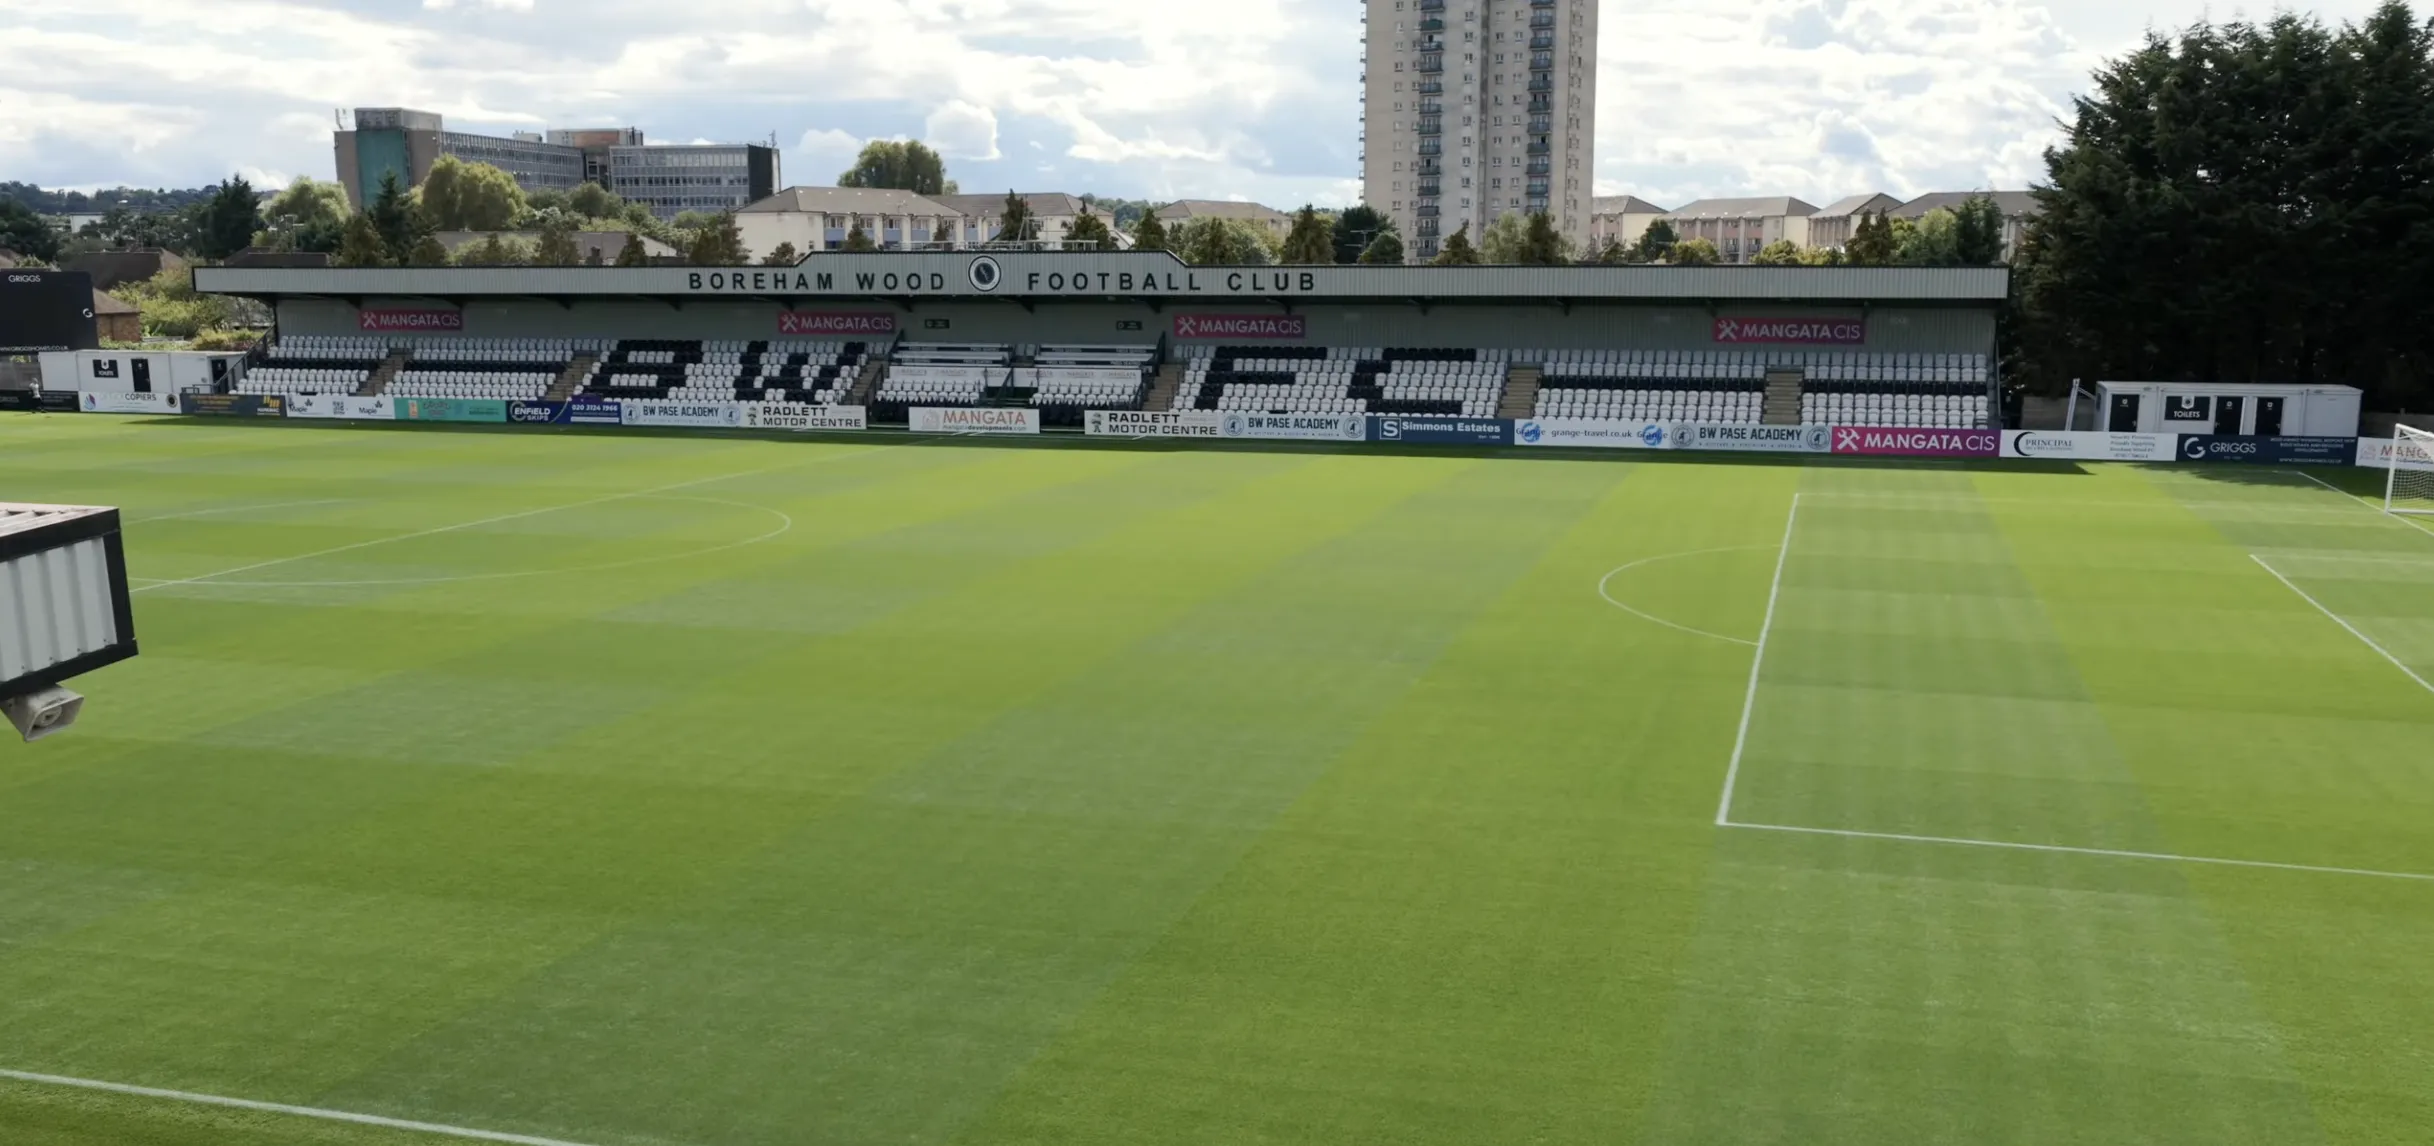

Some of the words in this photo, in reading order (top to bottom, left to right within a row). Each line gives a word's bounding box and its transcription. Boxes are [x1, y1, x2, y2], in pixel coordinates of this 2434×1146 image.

[8, 275, 41, 283] GRIGGS
[689, 272, 833, 290] BOREHAM
[856, 272, 944, 290] WOOD
[1028, 272, 1201, 291] FOOTBALL
[1227, 272, 1315, 291] CLUB
[379, 314, 440, 327] MANGATA
[440, 314, 461, 327] CIS
[801, 316, 869, 330] MANGATA
[871, 317, 893, 331] CIS
[1200, 319, 1277, 333] MANGATA
[1278, 320, 1302, 334] CIS
[1742, 323, 1832, 338] MANGATA
[1833, 325, 1861, 339] CIS
[125, 393, 156, 401] COPIERS
[290, 406, 308, 414] Maple
[359, 407, 378, 415] Maple
[514, 407, 551, 415] ENFIELD
[643, 405, 656, 416] BW
[658, 406, 679, 417] PASE
[681, 406, 719, 417] ACADEMY
[763, 406, 828, 417] RADLETT
[2173, 410, 2201, 418] TOILETS
[763, 417, 807, 426] MOTOR
[811, 418, 862, 428] CENTRE
[943, 410, 1026, 425] MANGATA
[1108, 412, 1181, 424] RADLETT
[1248, 417, 1263, 428] BW
[1266, 417, 1290, 429] PASE
[1293, 418, 1340, 430] ACADEMY
[1108, 424, 1158, 434] MOTOR
[1162, 425, 1218, 436] CENTRE
[1402, 421, 1454, 432] Simmons
[1457, 422, 1501, 433] Estates
[1551, 429, 1632, 438] grange-travel.co.uk
[1699, 427, 1717, 439] BW
[1720, 428, 1747, 440] PASE
[1750, 428, 1802, 441] ACADEMY
[1863, 432, 1963, 450] MANGATA
[1965, 435, 1995, 451] CIS
[2025, 438, 2072, 447] PRINCIPAL
[2210, 442, 2257, 454] GRIGGS
